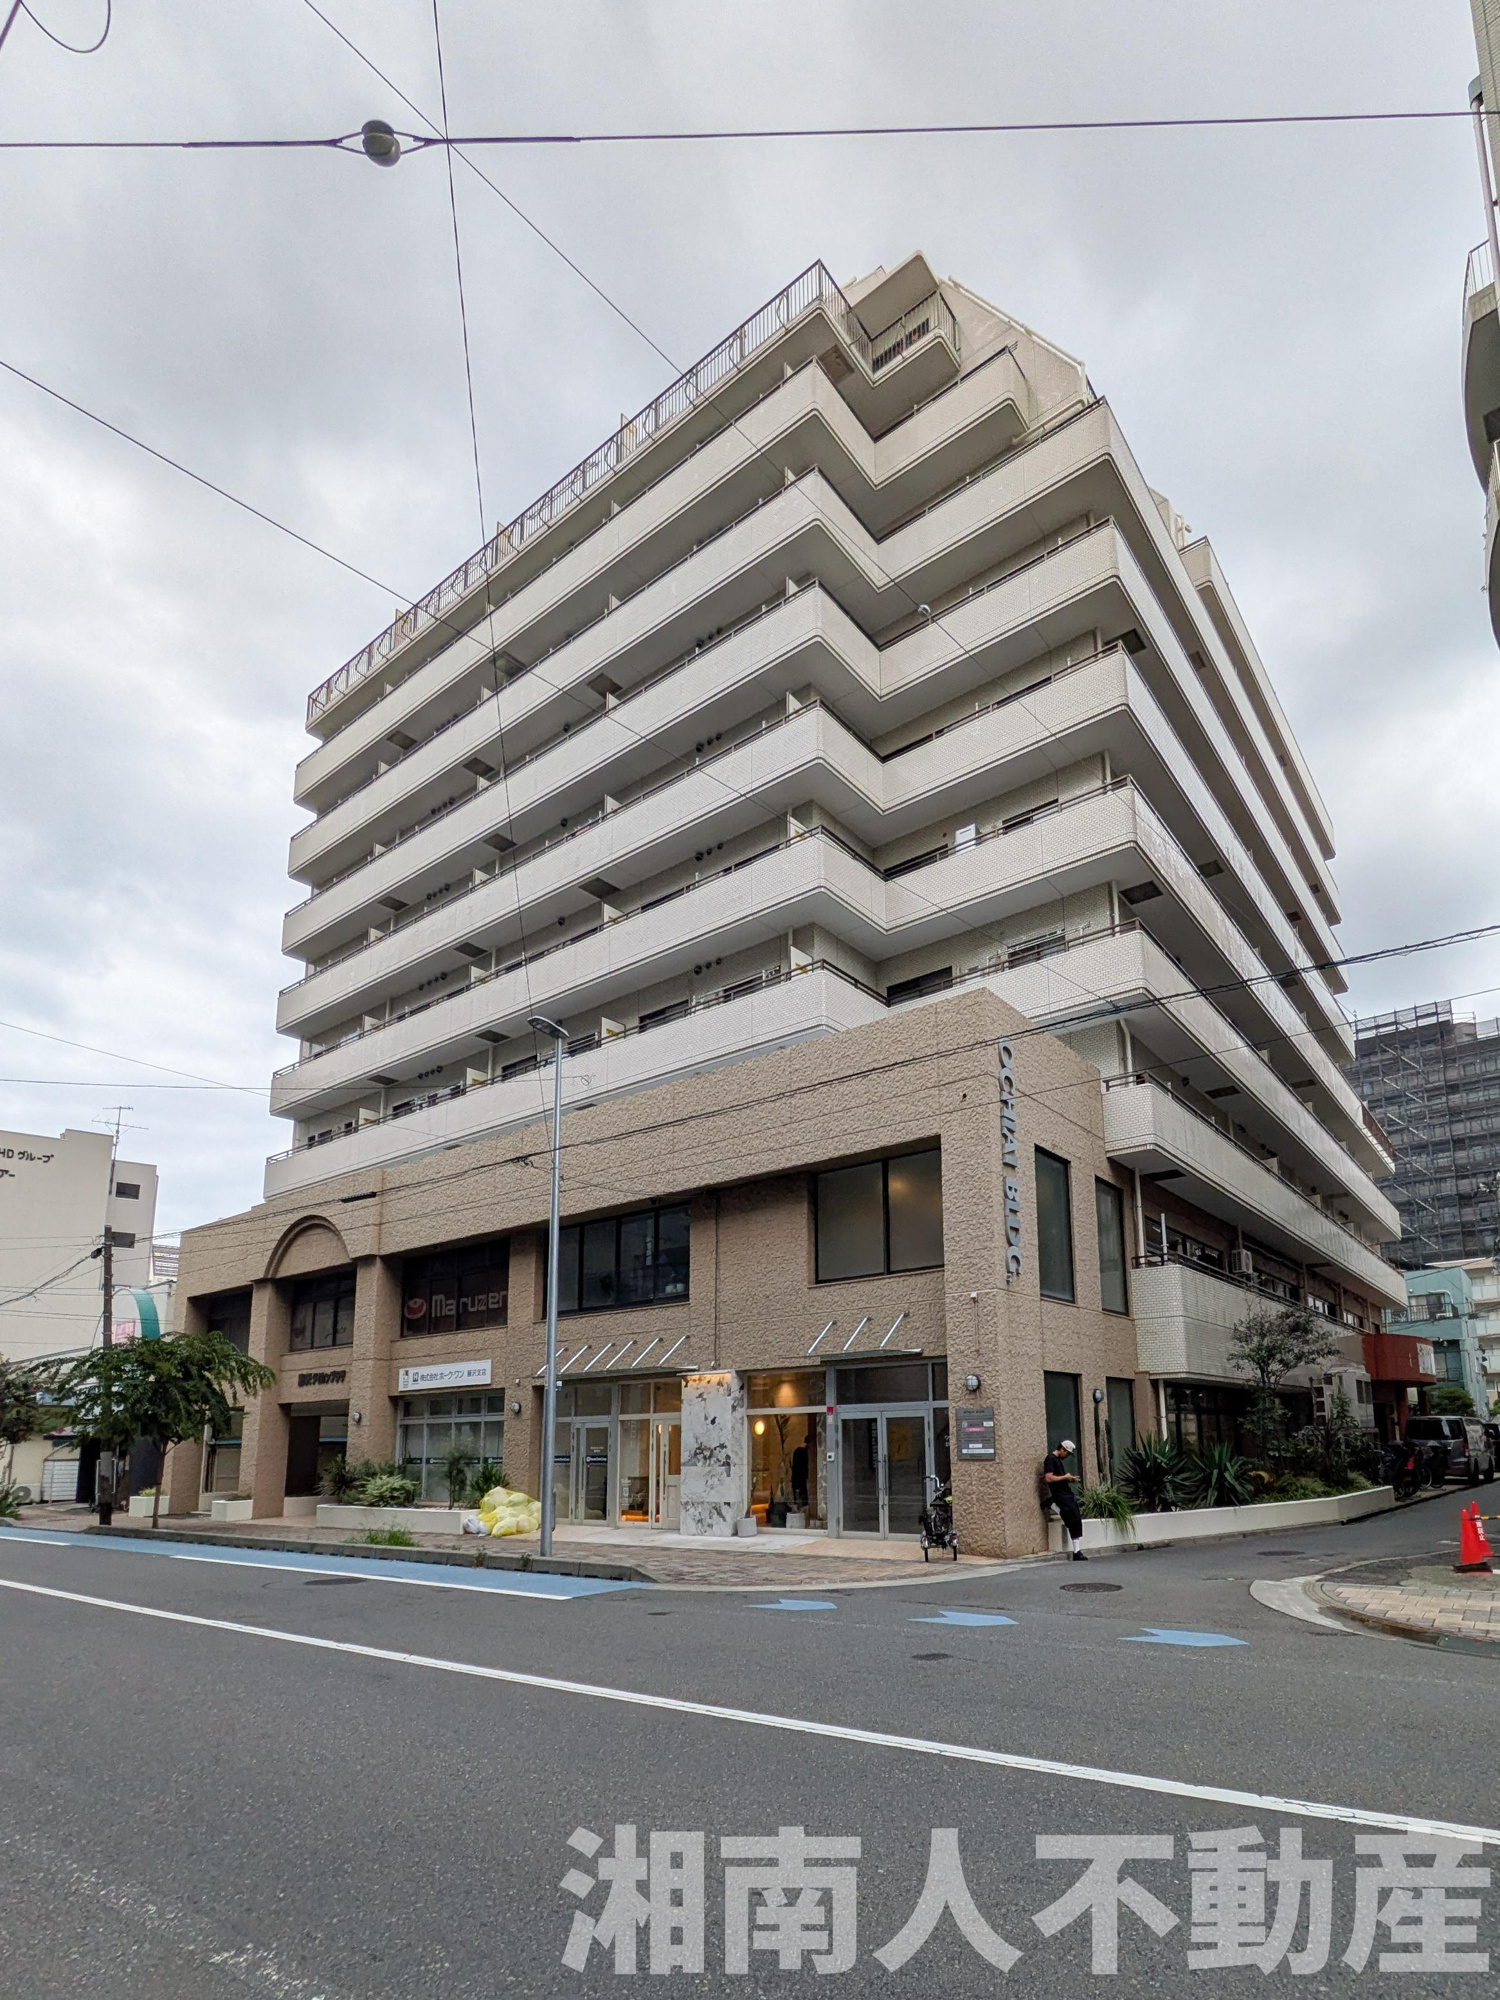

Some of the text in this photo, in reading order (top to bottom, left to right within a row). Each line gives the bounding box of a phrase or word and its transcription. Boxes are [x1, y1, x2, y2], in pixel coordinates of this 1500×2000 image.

[998, 1037, 1018, 1168] OCHIAI
[17, 1150, 55, 1163] グループ
